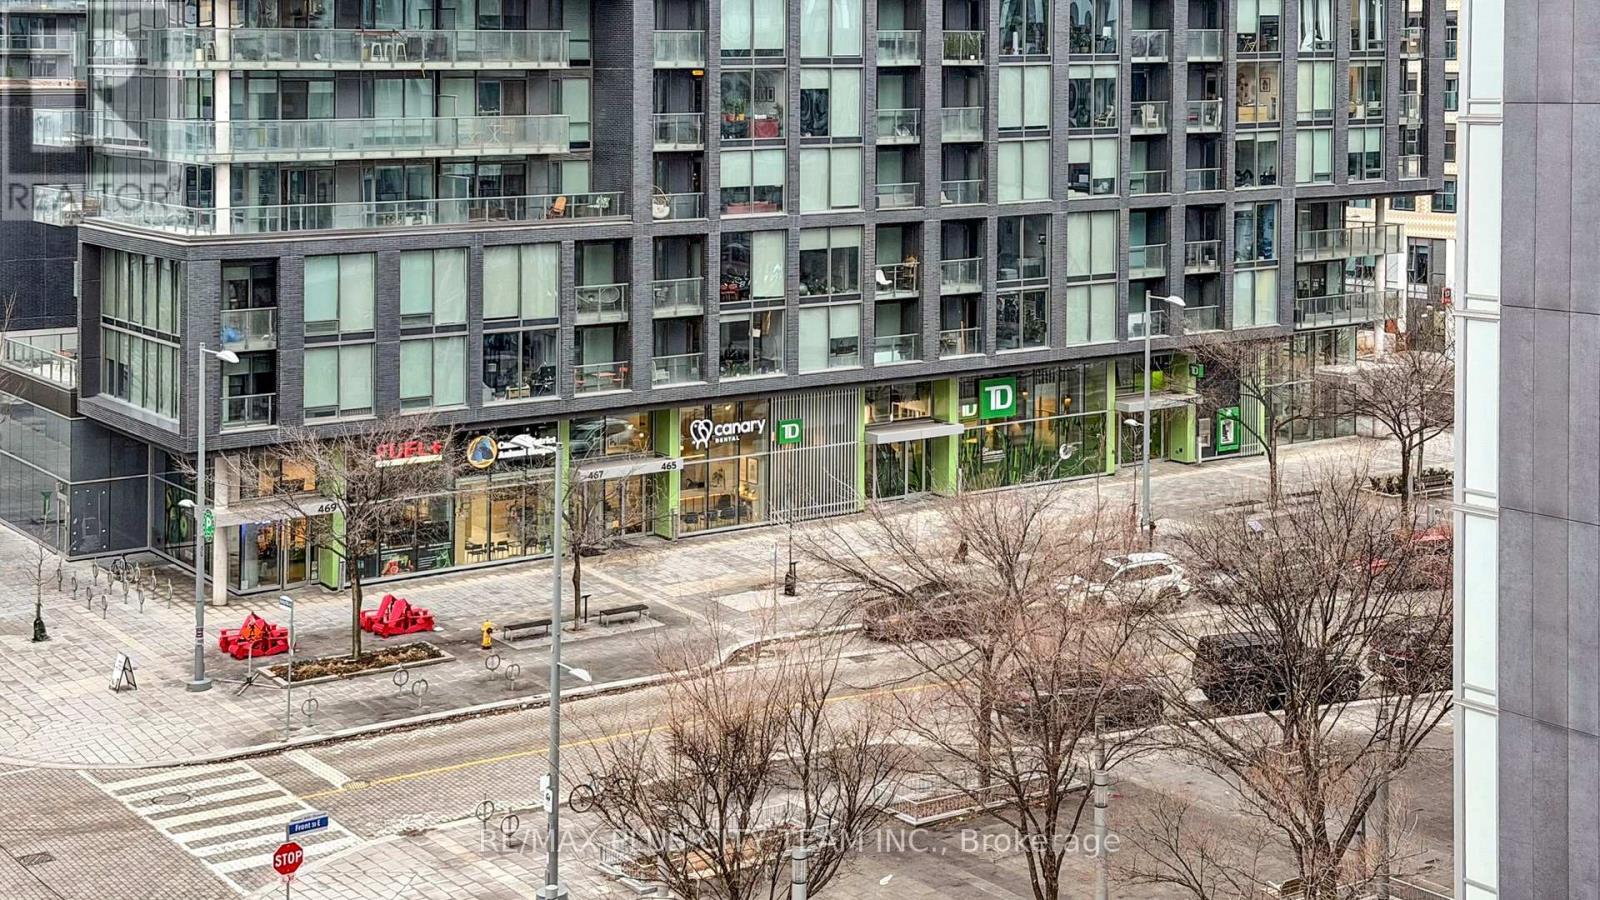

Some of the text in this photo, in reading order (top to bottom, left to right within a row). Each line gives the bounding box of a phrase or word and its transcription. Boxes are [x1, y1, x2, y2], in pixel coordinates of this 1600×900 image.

[985, 384, 1013, 411] TD
[714, 418, 766, 437] canary
[781, 423, 800, 440] TD
[715, 435, 740, 443] DENTAL
[661, 461, 677, 470] 465
[588, 470, 604, 479] 467
[318, 502, 337, 514] 469
[295, 822, 311, 832] Front
[275, 850, 303, 868] STOP
